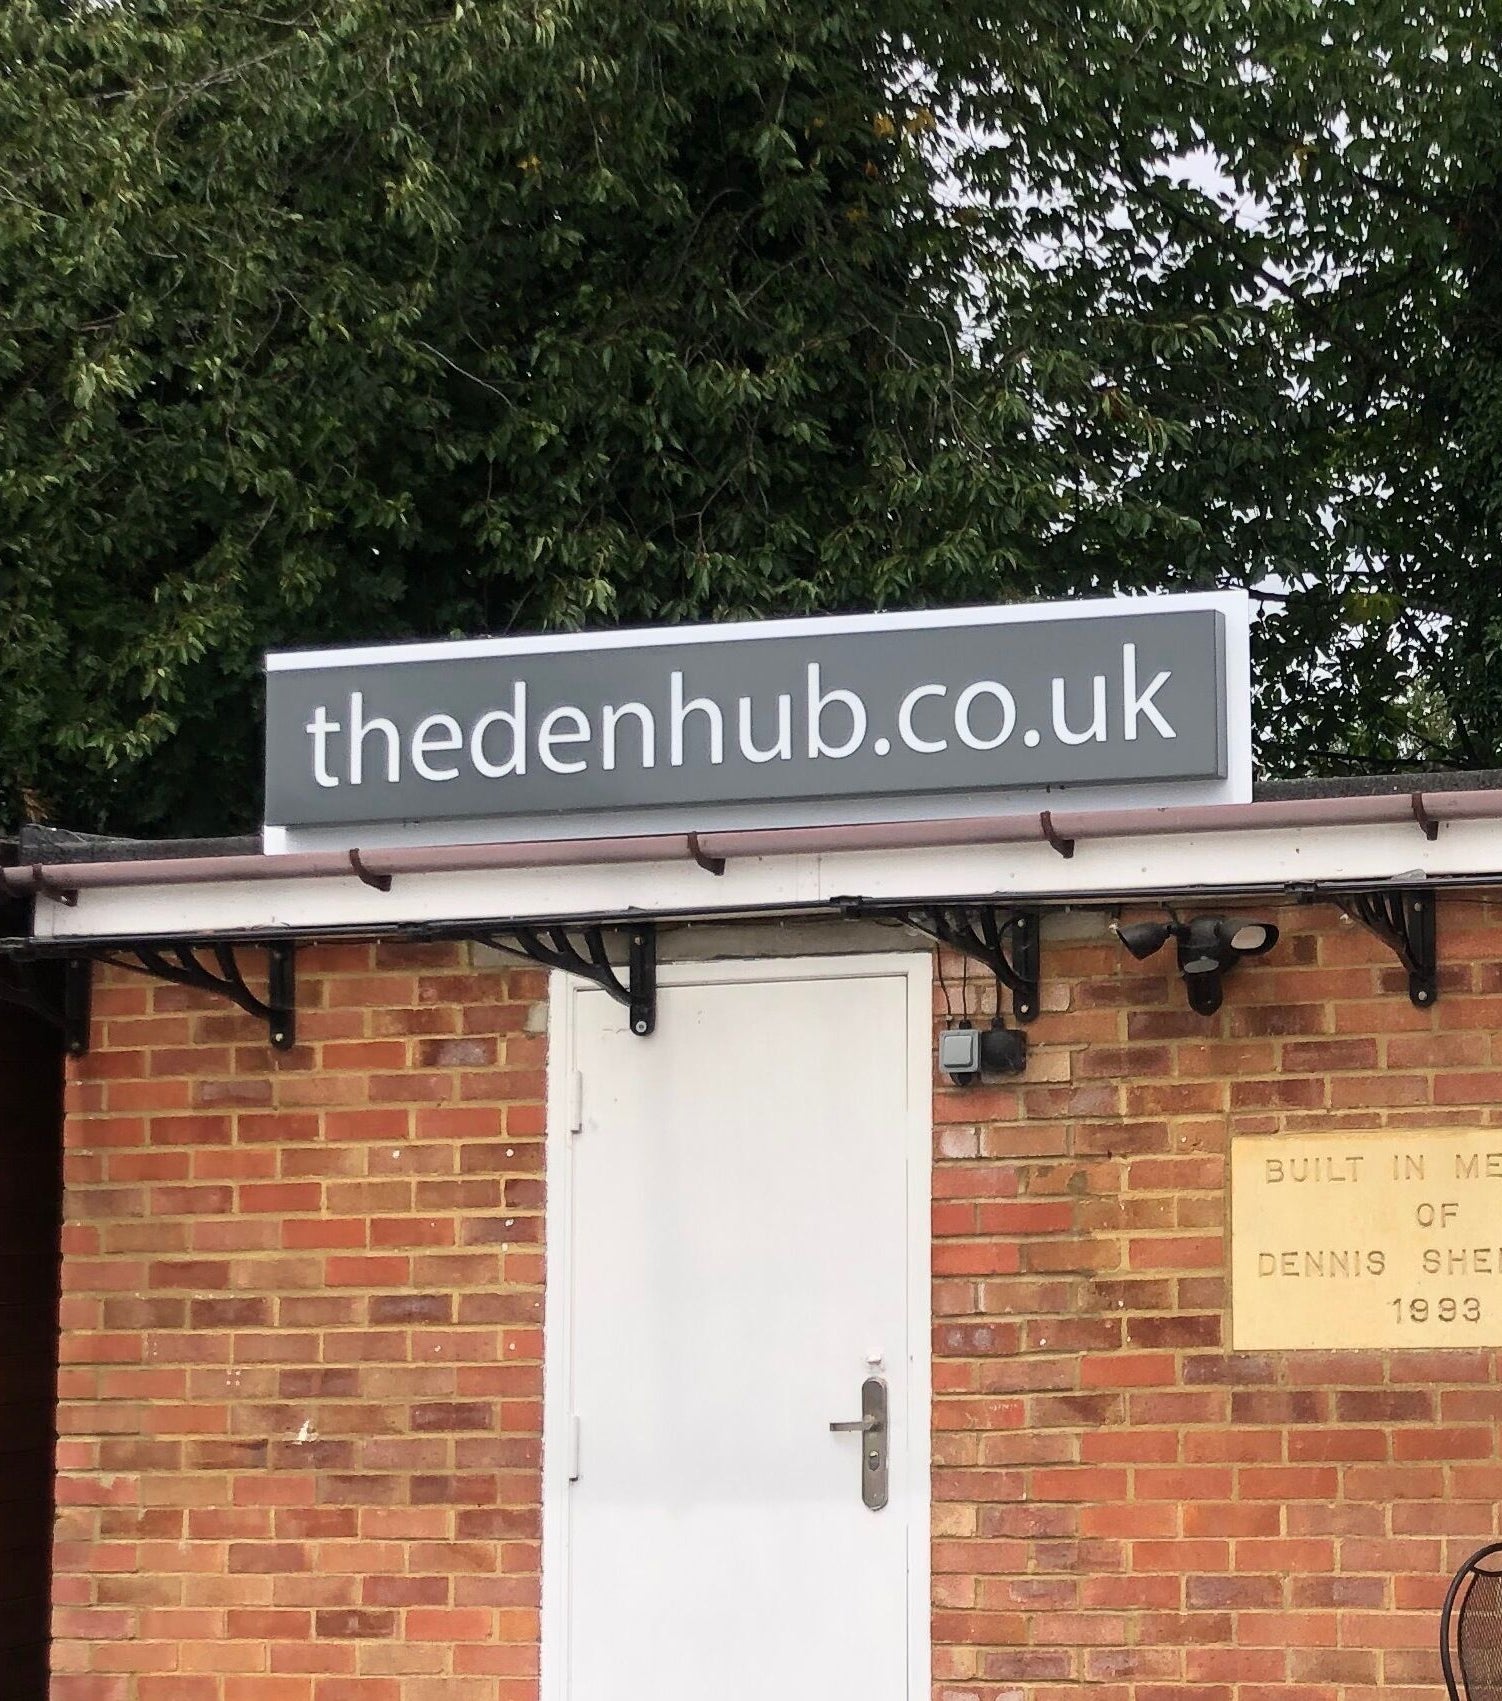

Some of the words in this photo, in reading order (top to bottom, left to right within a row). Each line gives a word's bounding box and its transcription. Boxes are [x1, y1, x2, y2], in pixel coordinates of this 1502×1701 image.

[304, 642, 1179, 788] thedenhub.co.uk
[1265, 1155, 1365, 1184] BUILT
[1393, 1153, 1426, 1181] IN
[1415, 1202, 1460, 1228] OF
[1257, 1249, 1387, 1278] DENNIS
[1390, 1297, 1482, 1325] 1993
